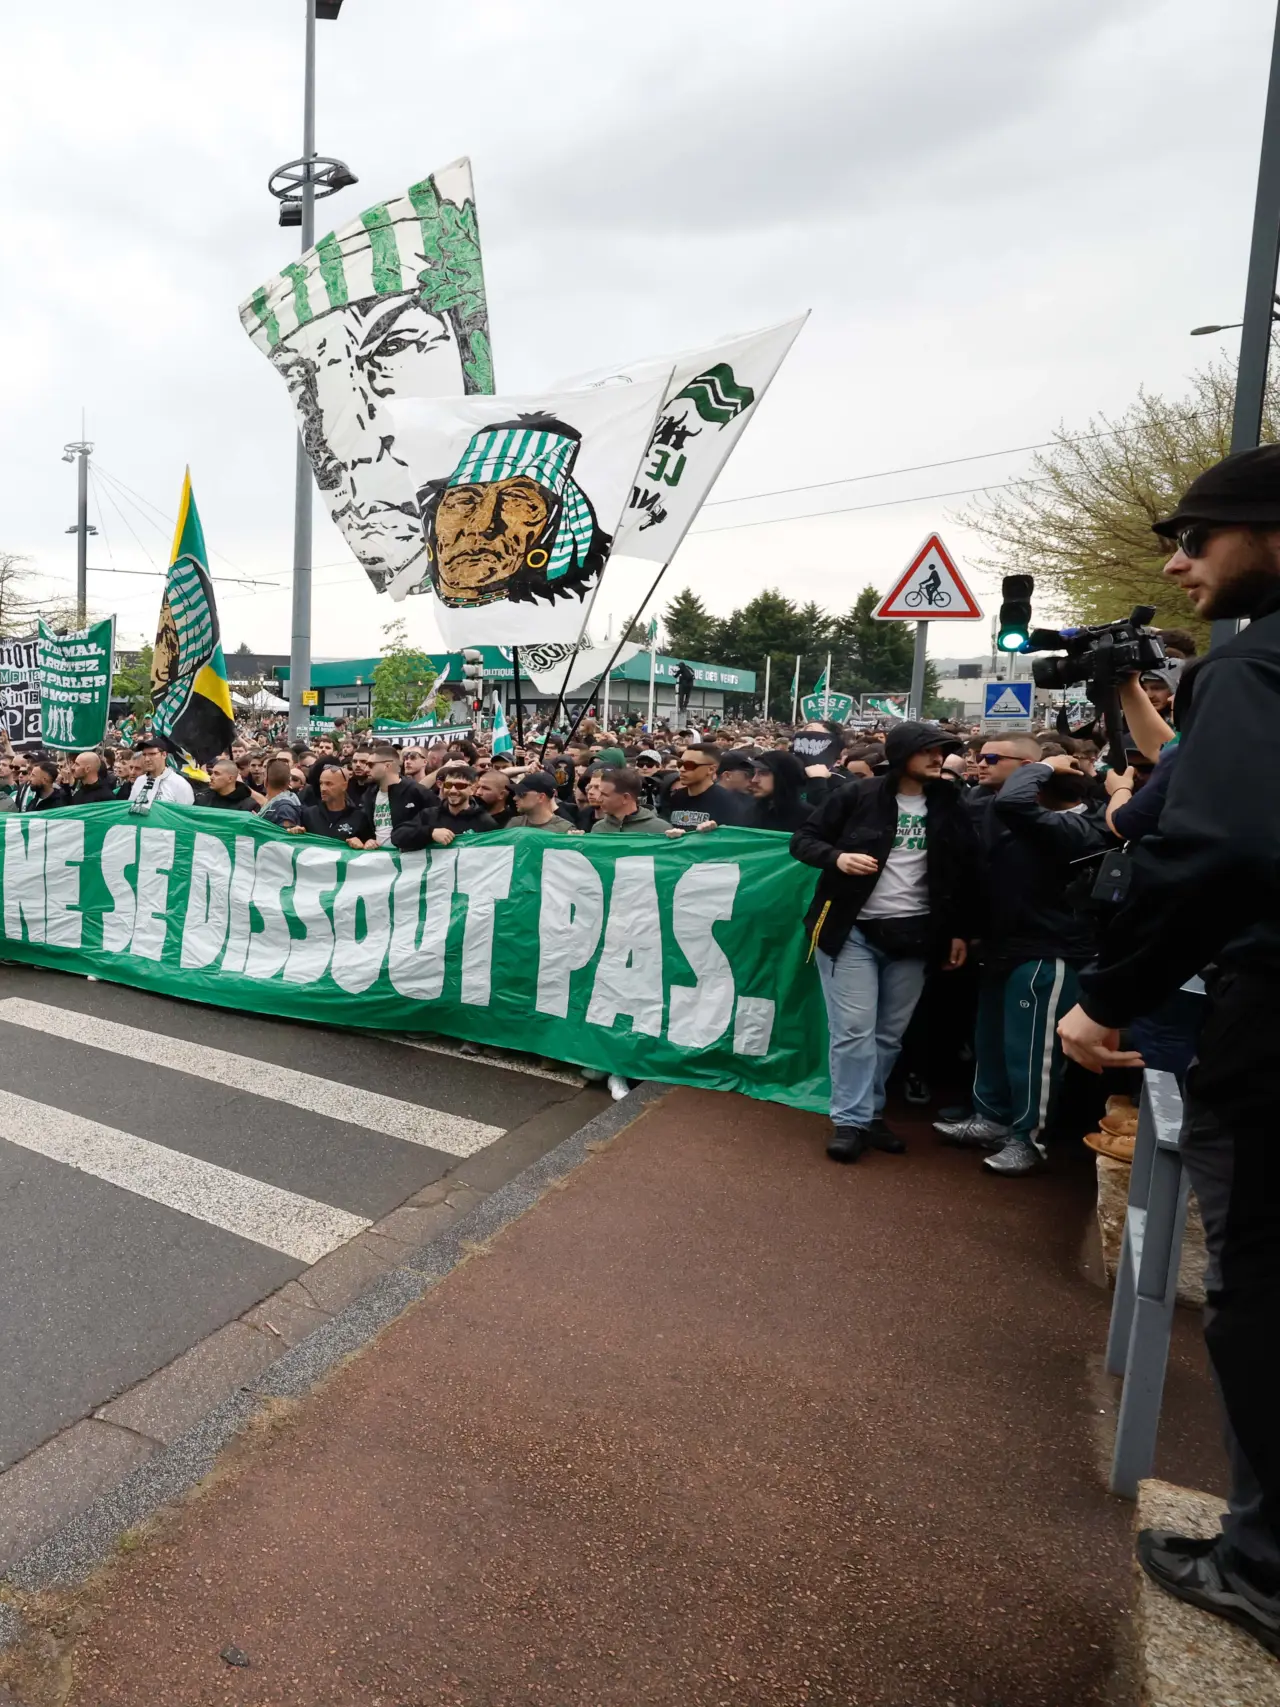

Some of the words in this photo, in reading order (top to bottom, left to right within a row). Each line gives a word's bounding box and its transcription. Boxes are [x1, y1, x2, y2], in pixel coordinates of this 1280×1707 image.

[63, 643, 106, 658] MAL,
[483, 668, 514, 677] OUTIQUE
[655, 663, 665, 675] LA
[705, 669, 718, 682] DES
[720, 672, 739, 685] VERTS
[46, 674, 107, 688] PARLER
[808, 698, 847, 709] ASSE
[3, 818, 85, 949] NE
[101, 825, 176, 962] SE
[179, 832, 516, 1007] DISSOUT
[535, 848, 776, 1057] PAS.
